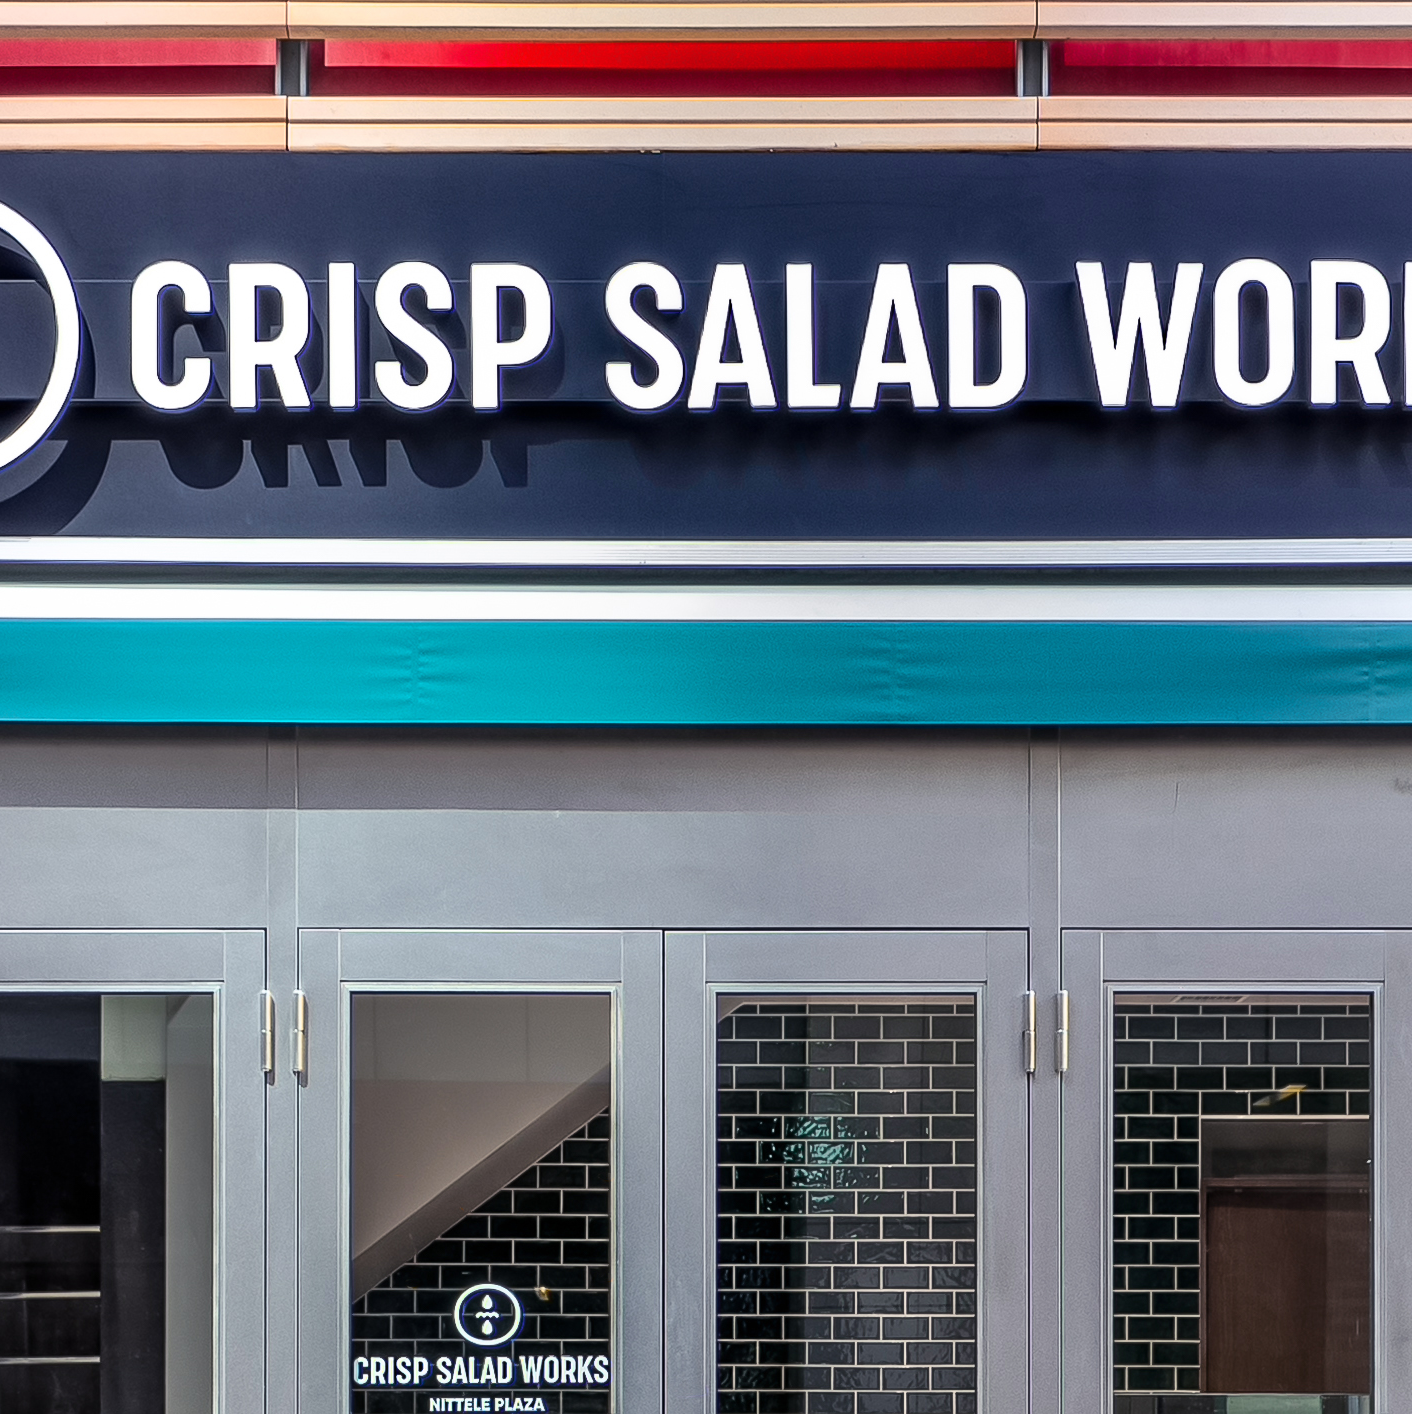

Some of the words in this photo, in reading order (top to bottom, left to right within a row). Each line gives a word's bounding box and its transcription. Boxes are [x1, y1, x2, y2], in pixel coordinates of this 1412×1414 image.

[131, 260, 552, 410] CRISP
[604, 260, 1027, 411] SALAD
[353, 1356, 429, 1385] CRISP
[436, 1356, 513, 1384] SALAD
[519, 1355, 609, 1384] WORKS
[429, 1397, 491, 1412] NITTELE
[494, 1397, 545, 1412] PLAZA
